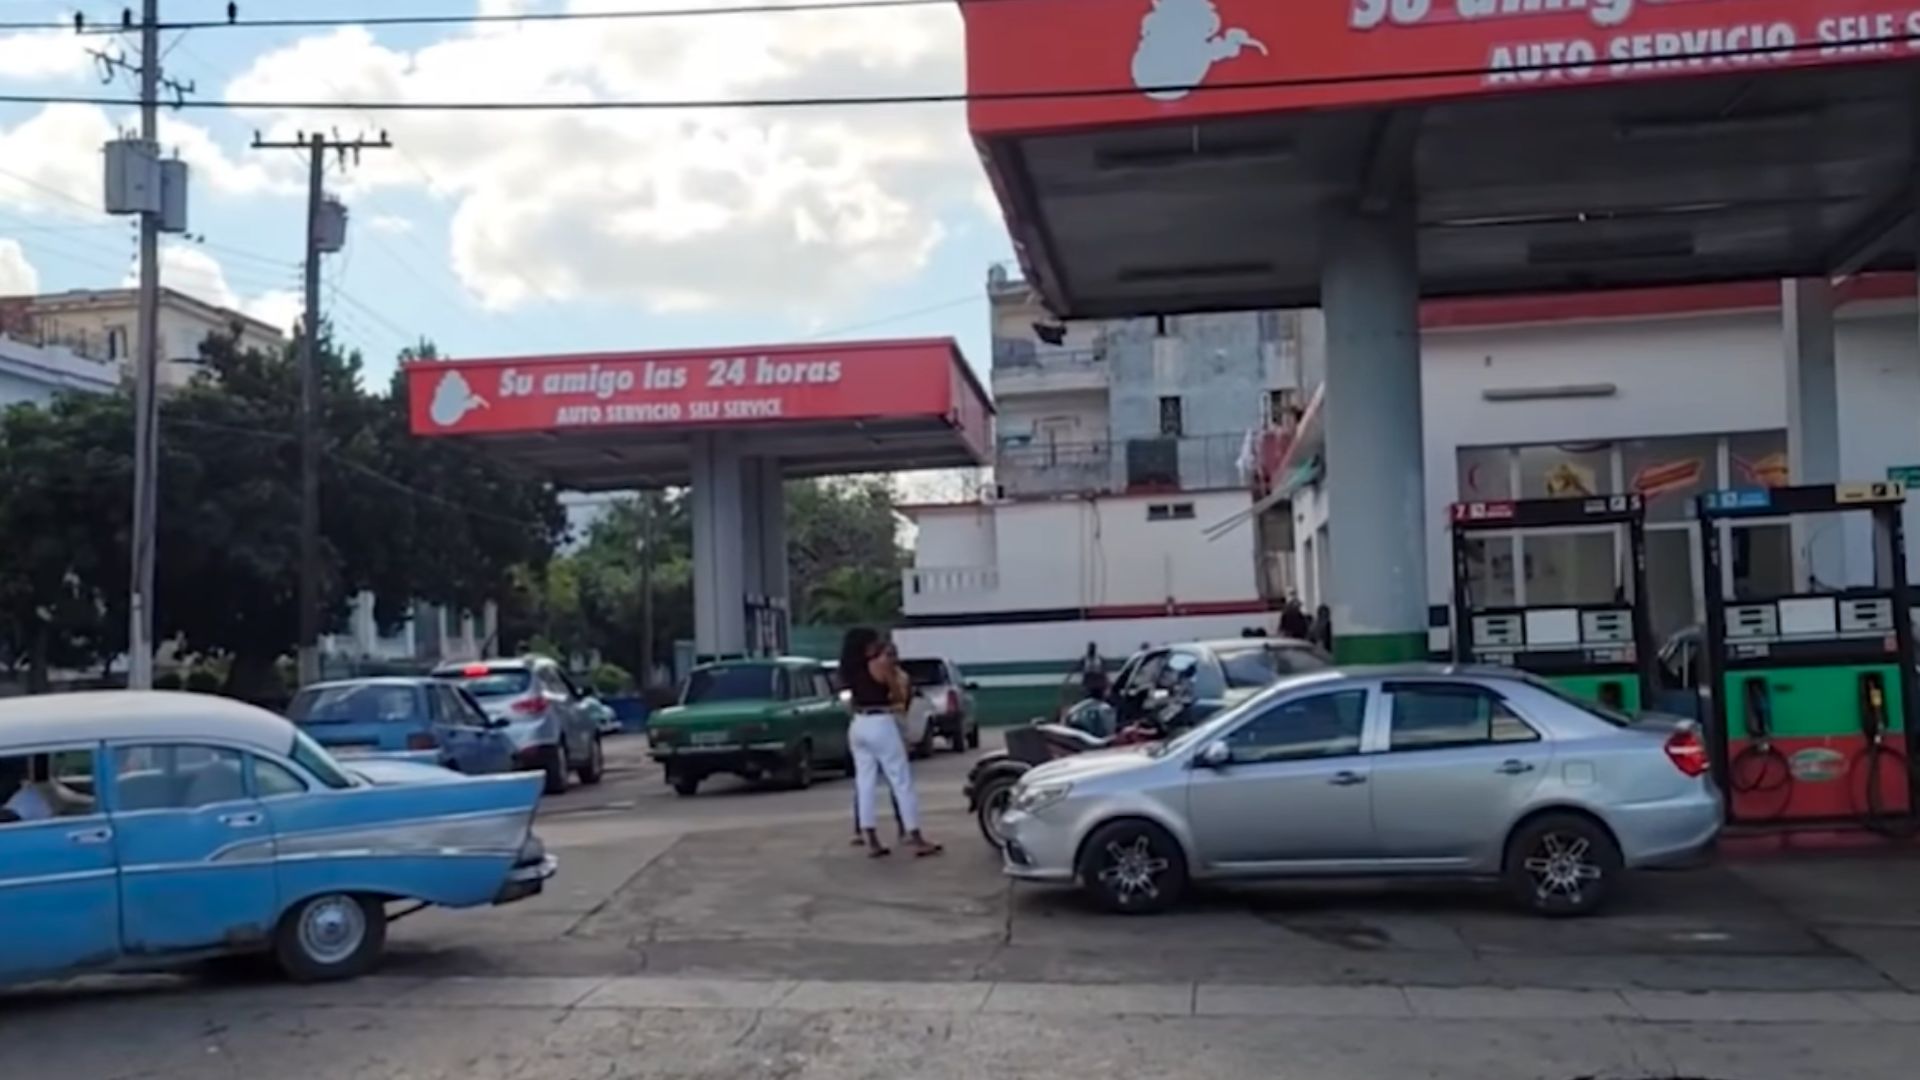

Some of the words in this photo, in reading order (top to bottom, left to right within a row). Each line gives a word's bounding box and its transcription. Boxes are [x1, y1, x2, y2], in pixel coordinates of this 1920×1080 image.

[1487, 39, 1596, 83] AUTO
[1610, 21, 1796, 73] SERVICIO
[1817, 14, 1894, 56] SELF
[499, 367, 533, 397] Su
[542, 363, 634, 399] amigo
[643, 360, 687, 390] las
[707, 357, 747, 387] 24
[755, 356, 842, 385] horas
[556, 405, 602, 425] AUTO
[606, 402, 682, 423] SERVICIO
[723, 397, 783, 418] SERVICE
